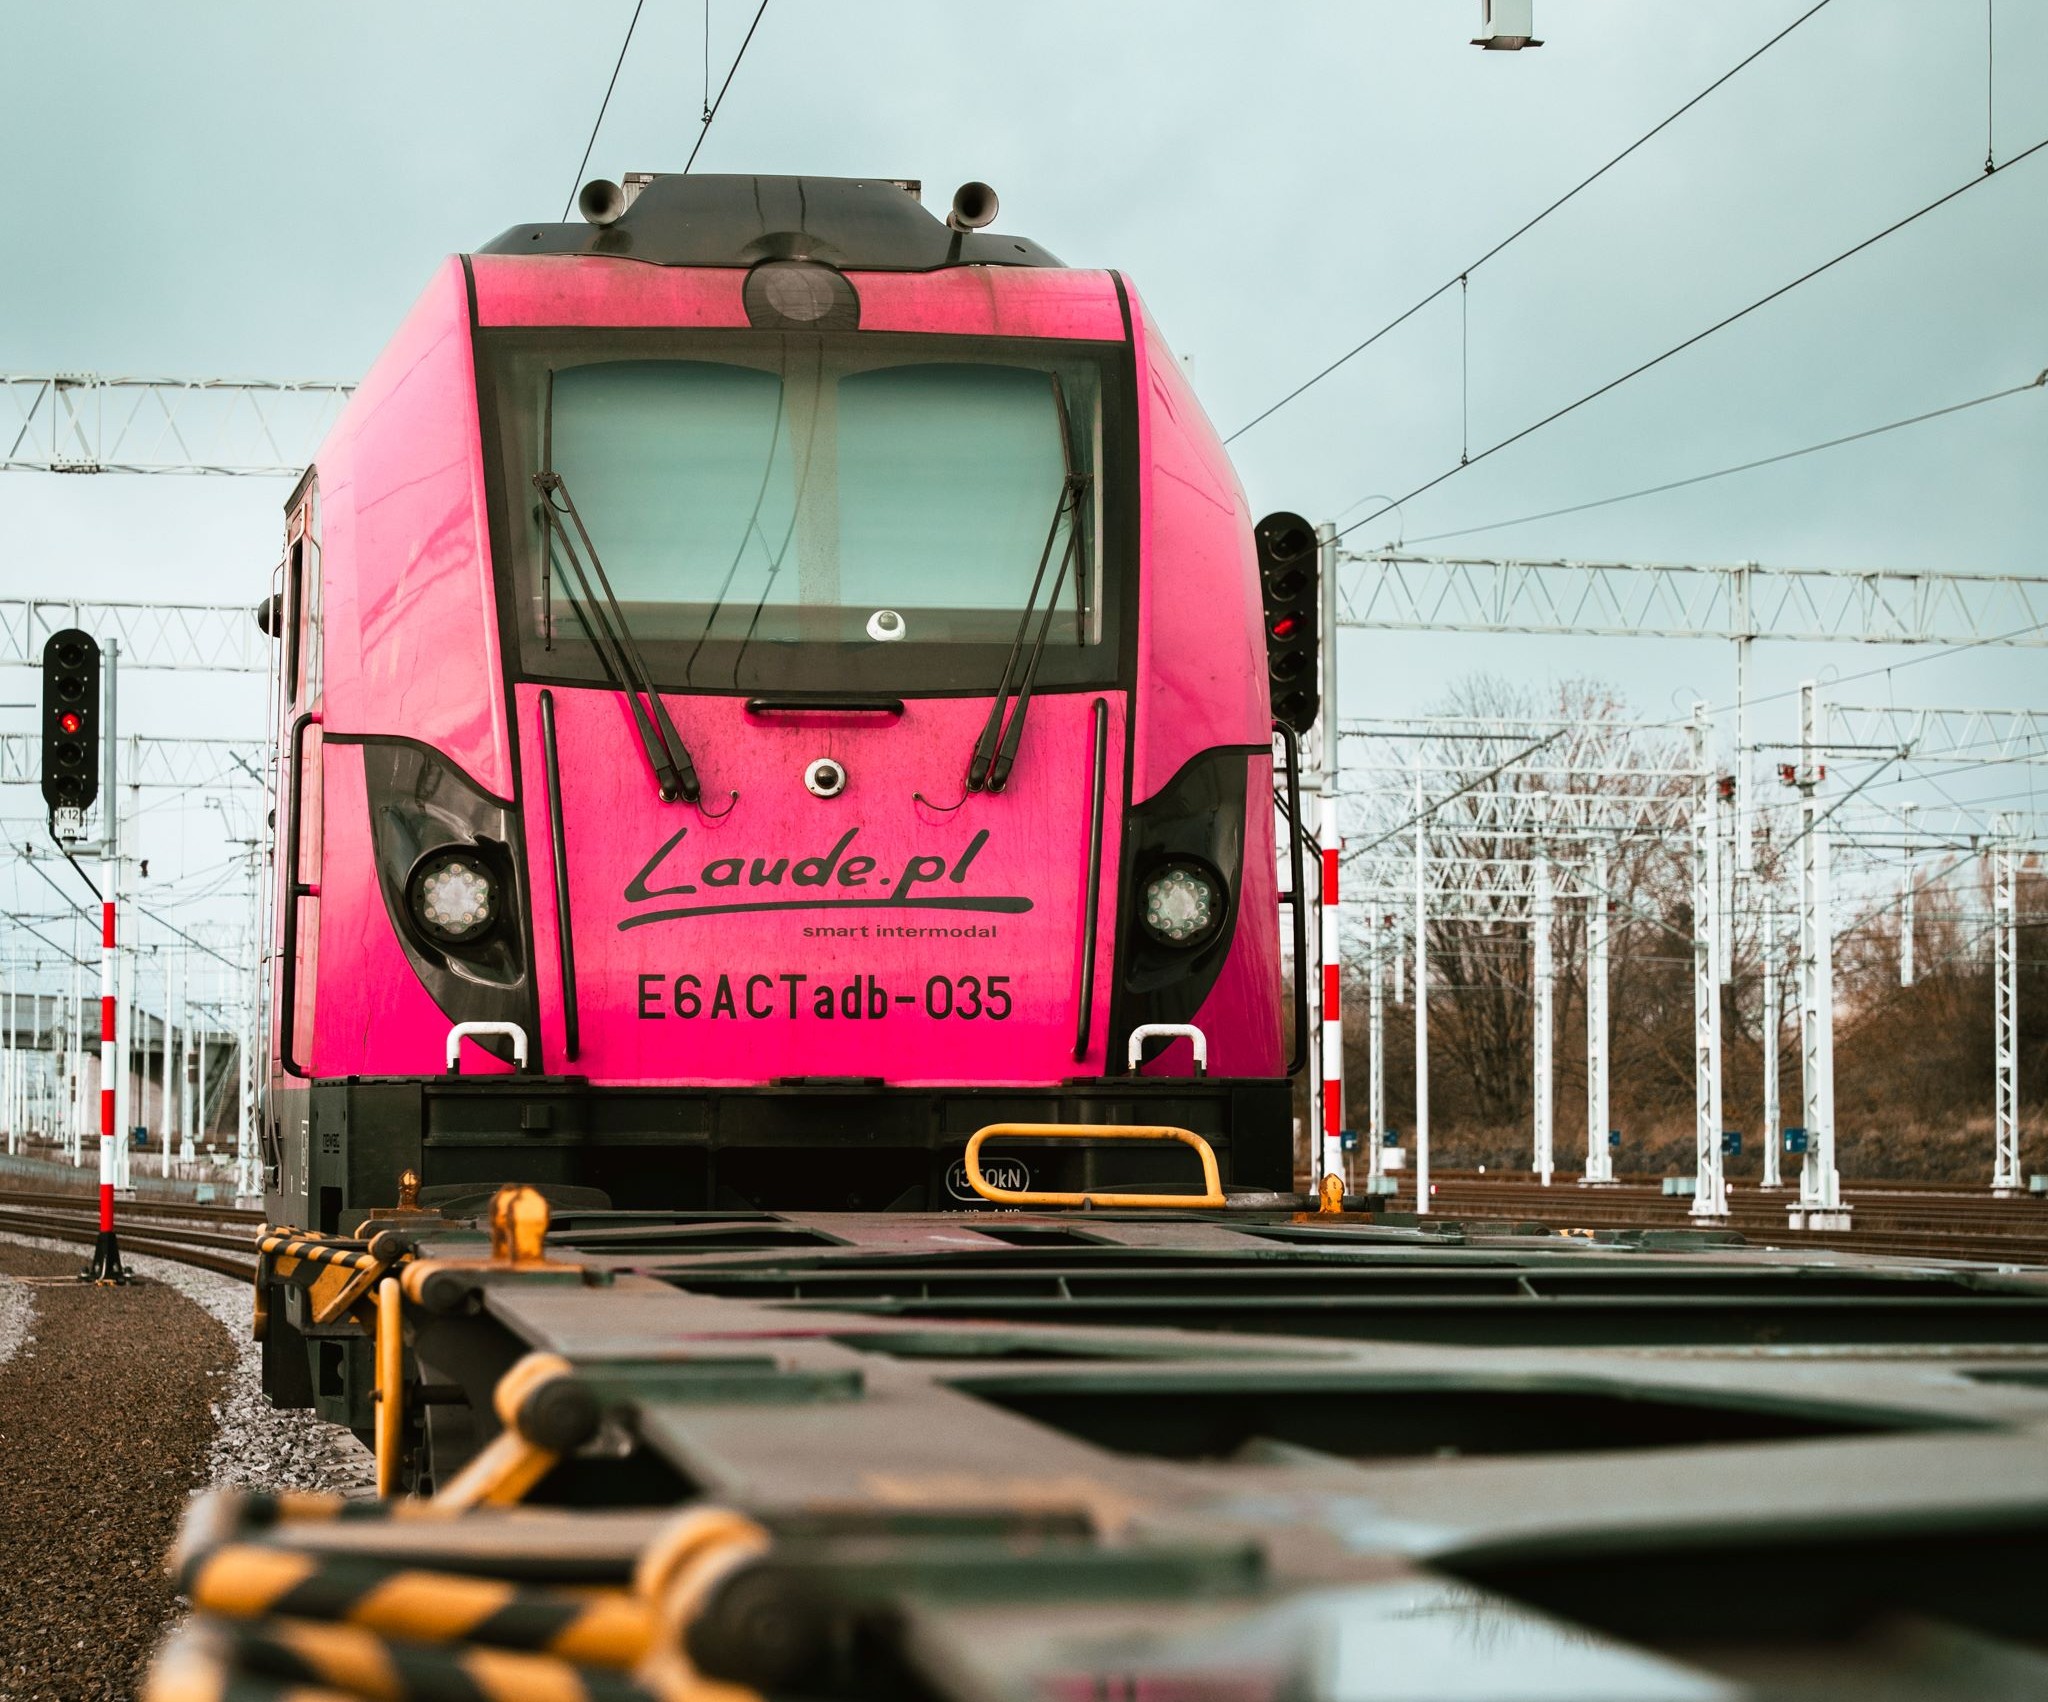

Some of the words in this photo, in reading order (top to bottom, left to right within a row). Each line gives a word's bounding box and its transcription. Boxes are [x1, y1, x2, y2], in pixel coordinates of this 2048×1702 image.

[60, 809, 79, 820] K12
[624, 827, 990, 903] Laude.pl
[803, 924, 869, 938] smart
[876, 924, 998, 938] intermodal
[638, 973, 1012, 1021] E6ACTadb-035
[953, 1169, 1021, 1188] 130kN
